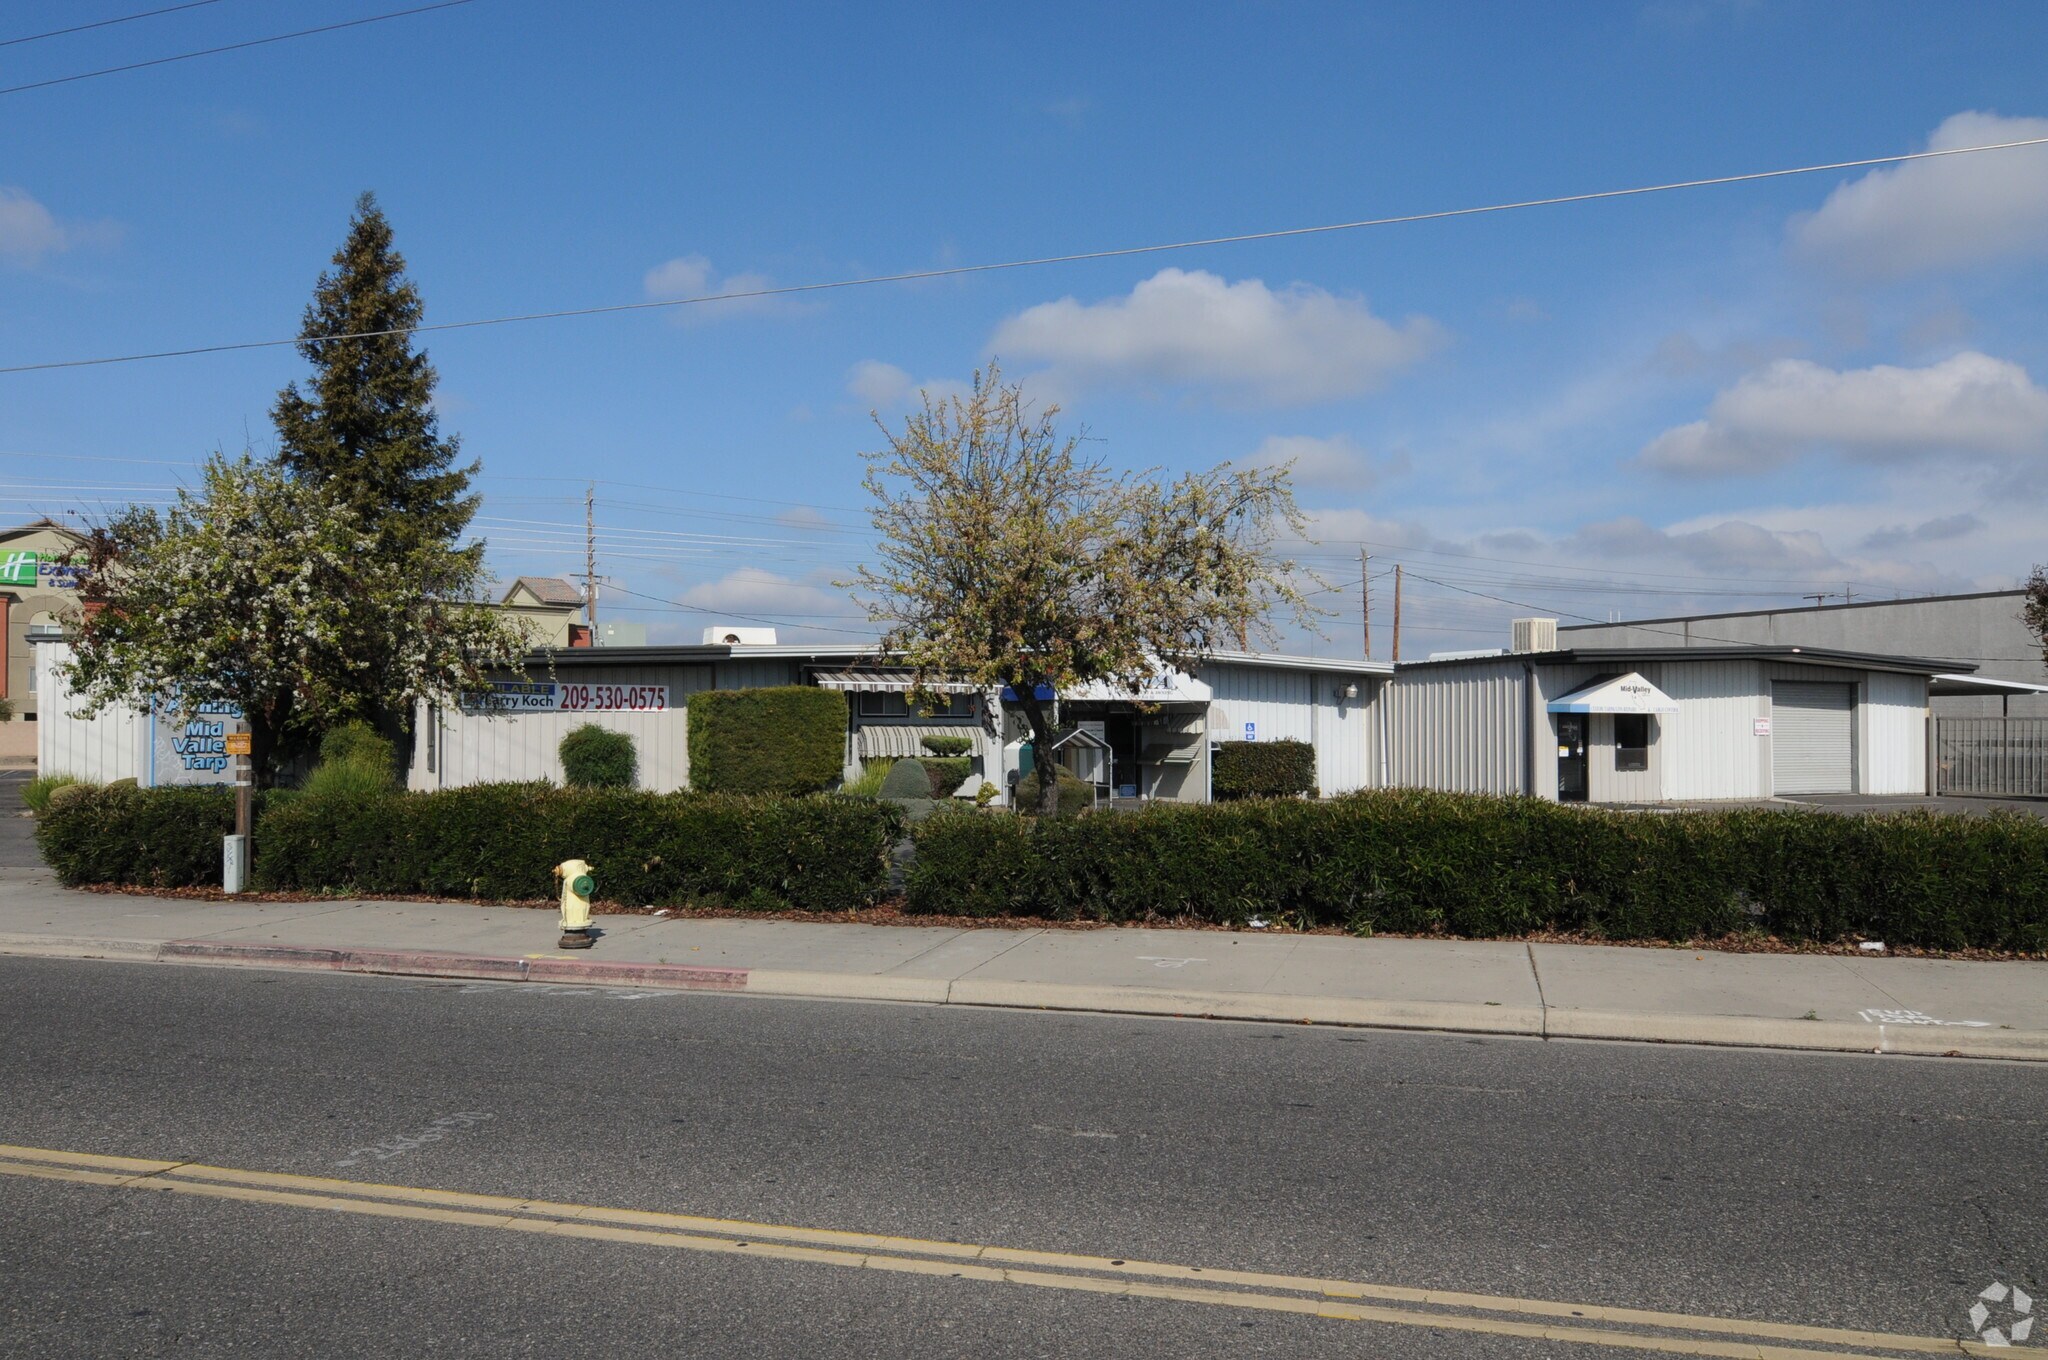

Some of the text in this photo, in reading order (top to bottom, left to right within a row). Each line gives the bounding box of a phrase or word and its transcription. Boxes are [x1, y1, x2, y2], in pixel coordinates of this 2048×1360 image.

[39, 562, 93, 577] Expre
[522, 694, 554, 707] Koch
[560, 685, 665, 710] 209-530-0575
[164, 698, 243, 719] Aning
[185, 721, 224, 737] Mid
[182, 754, 228, 774] Tarp
